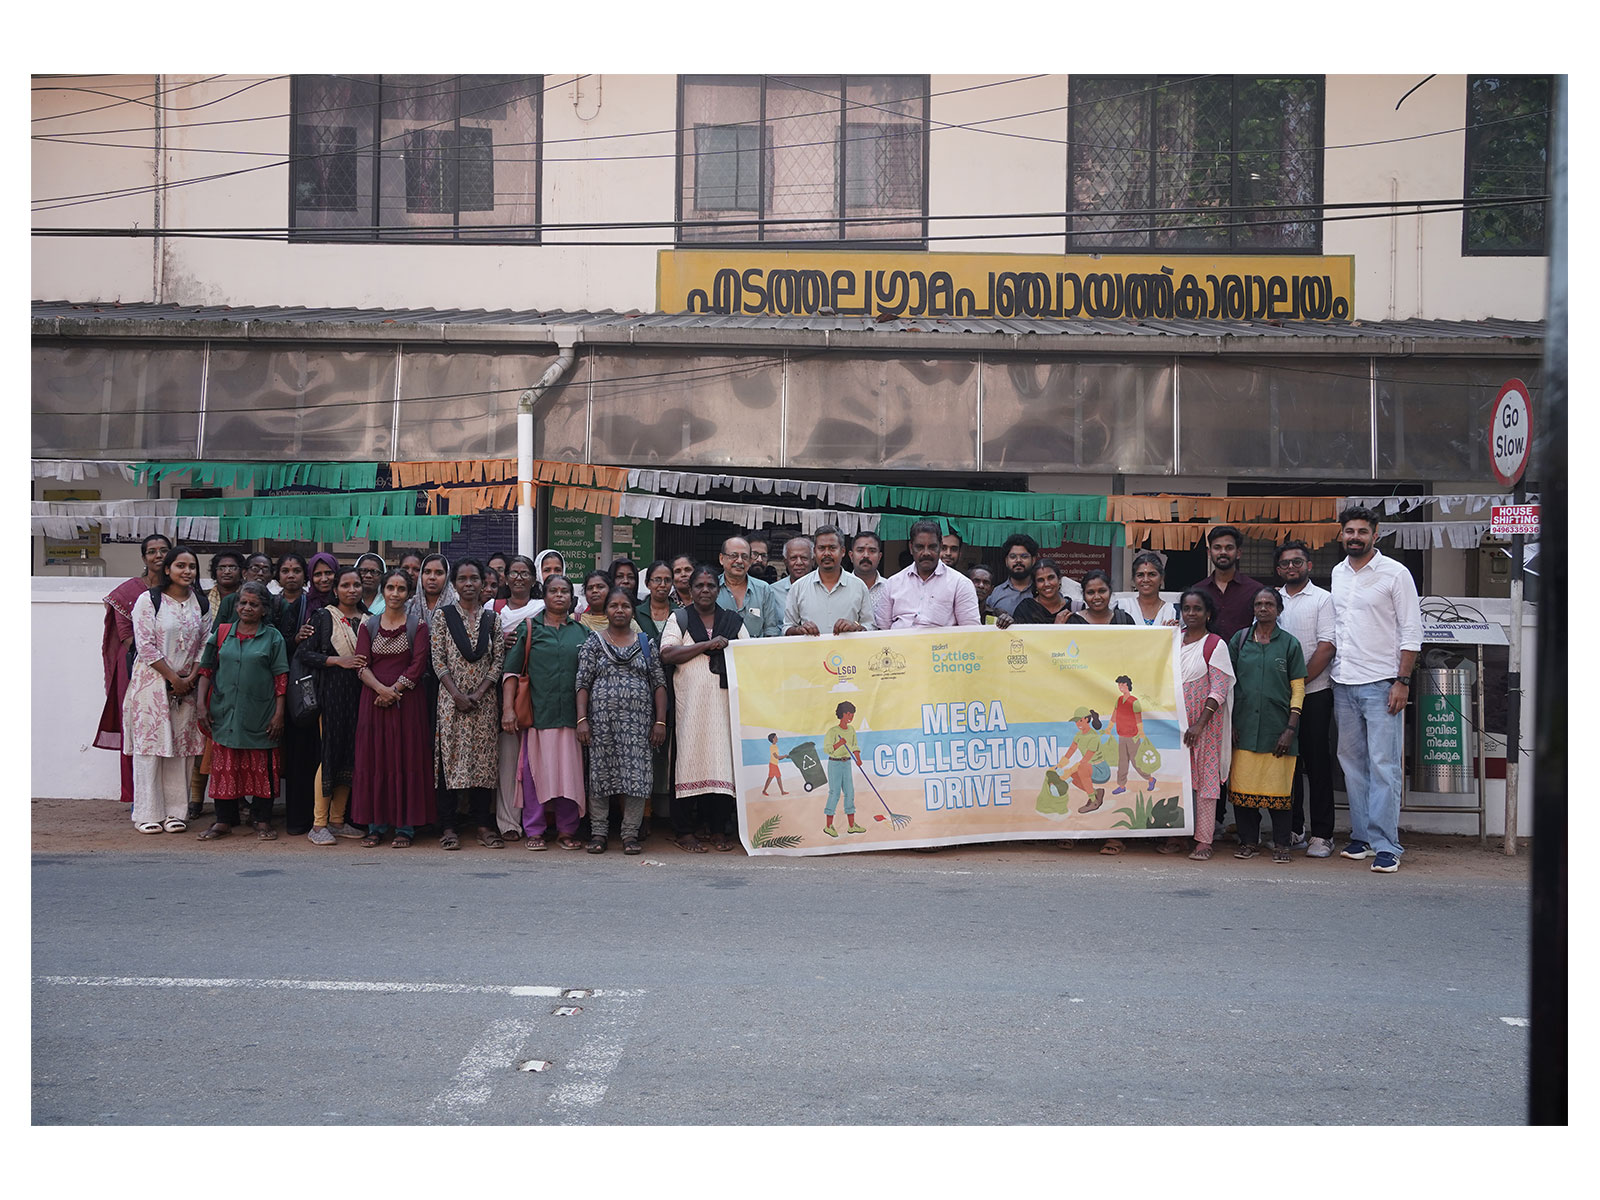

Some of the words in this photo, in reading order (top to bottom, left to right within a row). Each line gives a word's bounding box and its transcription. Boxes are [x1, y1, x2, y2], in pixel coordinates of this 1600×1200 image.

[1502, 404, 1519, 428] Go
[1496, 435, 1524, 458] Slow
[1499, 507, 1533, 516] HOUSE
[1493, 515, 1539, 524] SHIFTING
[559, 550, 587, 559] GNRES
[932, 650, 976, 662] bottles
[837, 665, 857, 675] LSGD
[933, 662, 981, 674] change
[920, 701, 1007, 735] MEGA
[873, 736, 1059, 777] COLLECTION
[924, 774, 1012, 812] DRIVE
